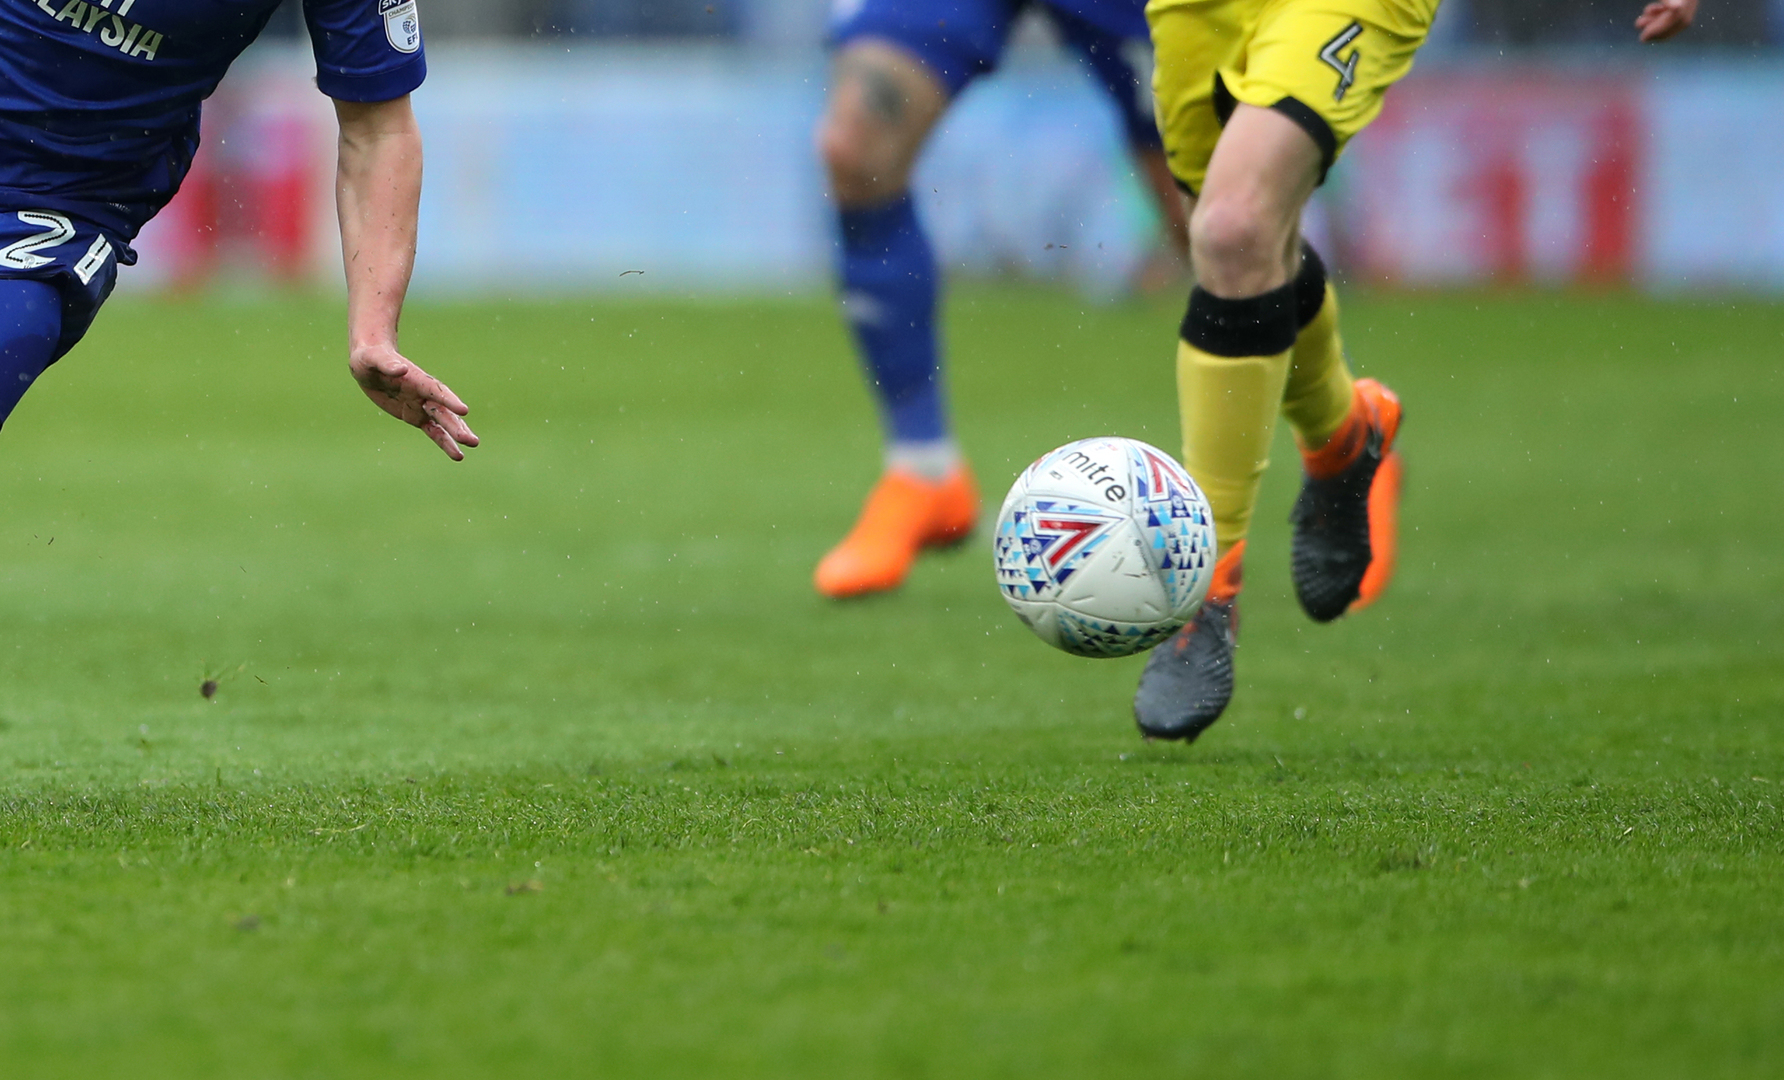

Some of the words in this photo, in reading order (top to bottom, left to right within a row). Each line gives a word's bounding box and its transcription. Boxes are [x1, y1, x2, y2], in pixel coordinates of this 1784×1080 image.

[388, 2, 415, 17] CHAMPIO
[1318, 20, 1363, 102] 4
[1062, 451, 1127, 503] mitre
